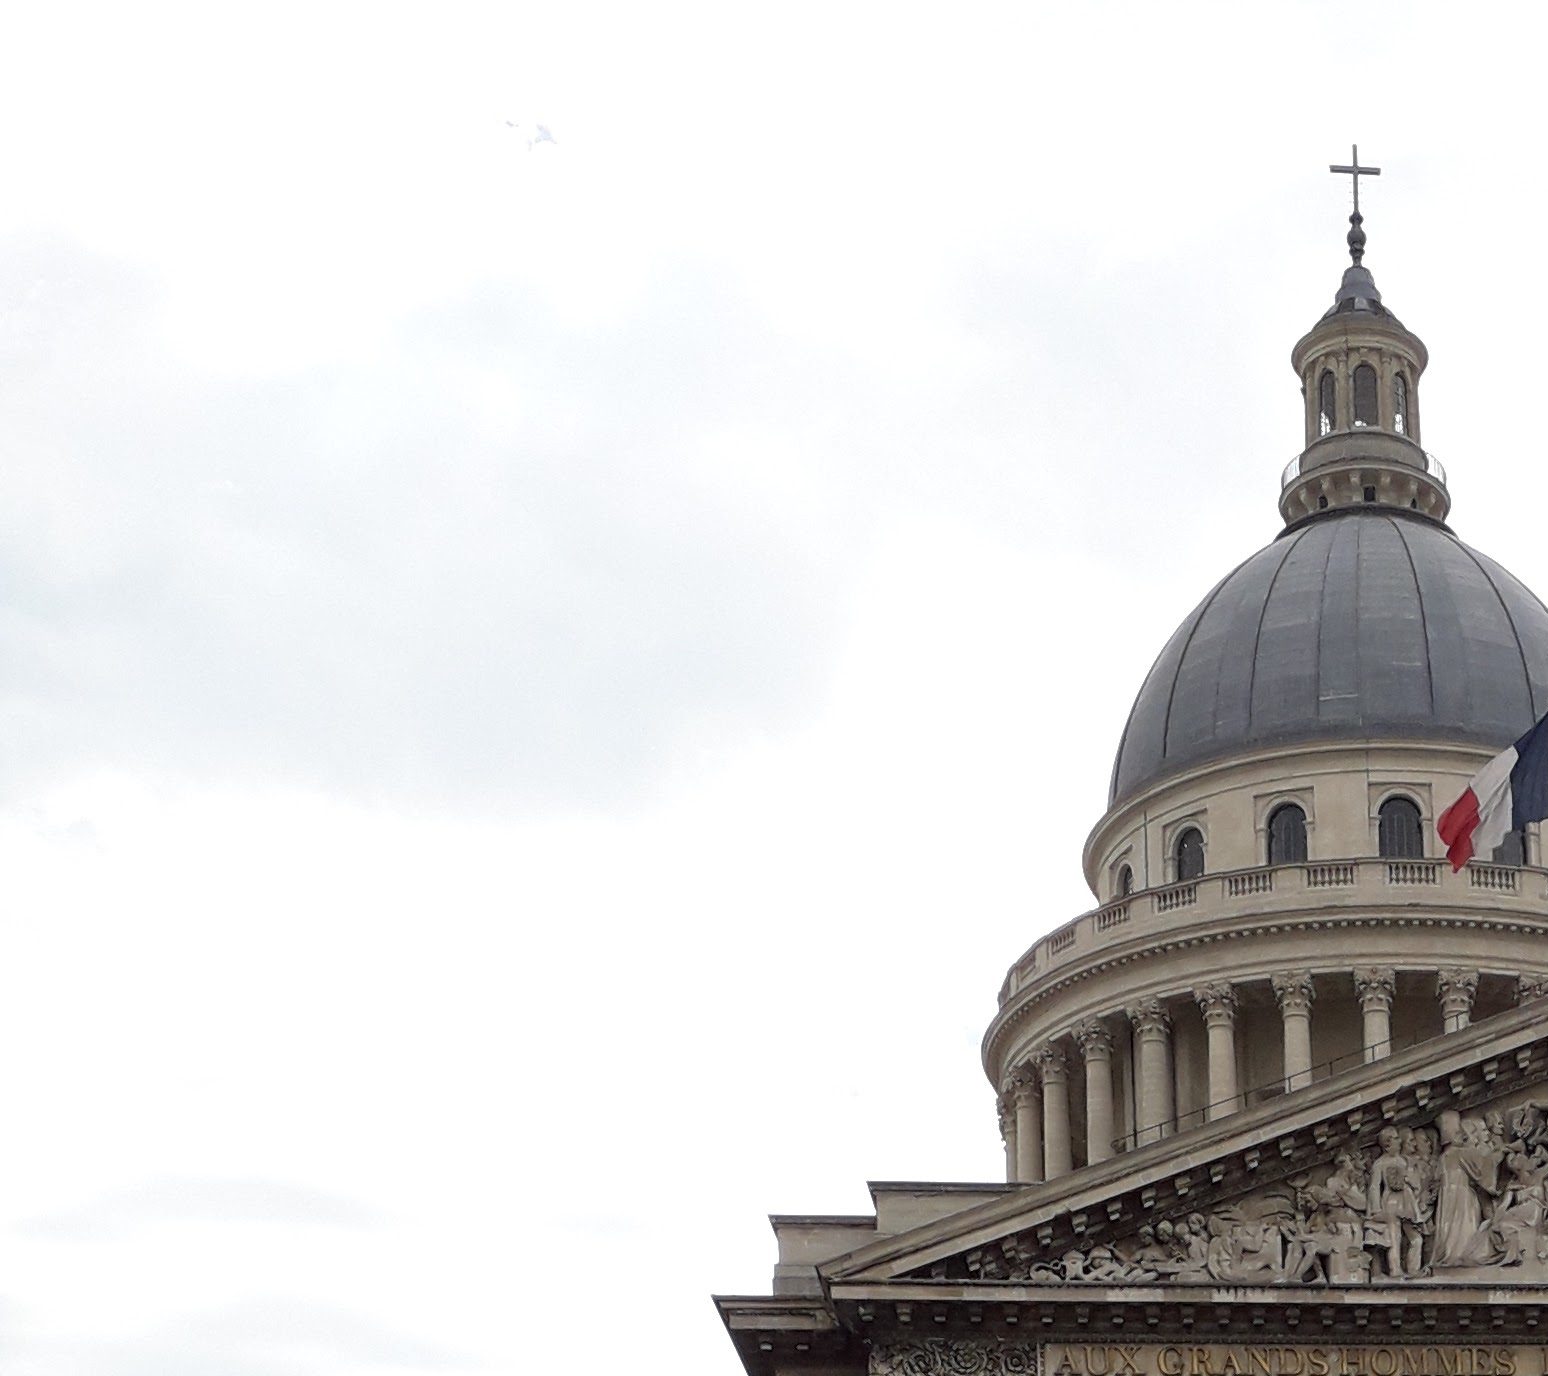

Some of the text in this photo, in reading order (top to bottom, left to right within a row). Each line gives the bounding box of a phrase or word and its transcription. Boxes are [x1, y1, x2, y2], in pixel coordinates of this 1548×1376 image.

[1054, 1346, 1147, 1376] AUX
[1156, 1346, 1331, 1376] GRANDS
[1338, 1346, 1517, 1376] HOMMES
